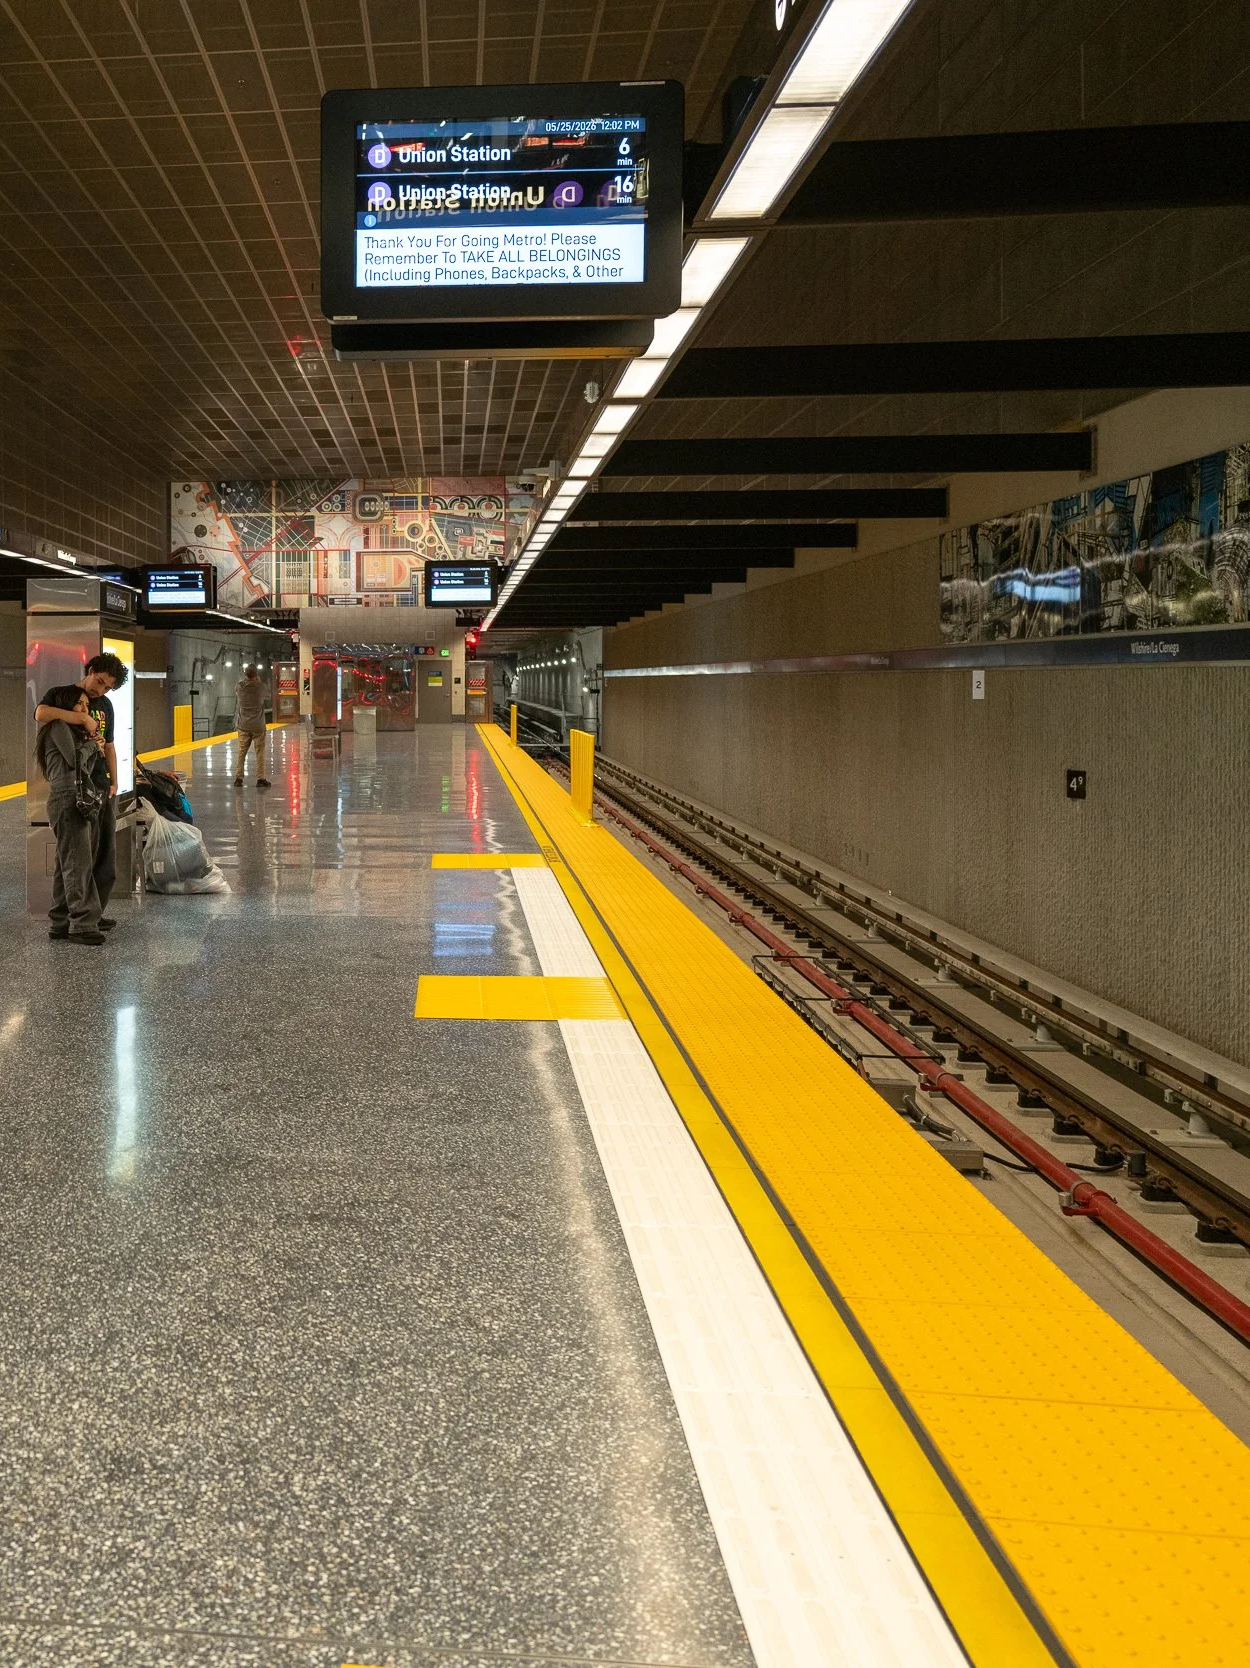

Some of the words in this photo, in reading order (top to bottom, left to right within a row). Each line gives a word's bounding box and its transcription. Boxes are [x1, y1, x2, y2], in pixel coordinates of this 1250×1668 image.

[545, 121, 597, 133] 05/25/2026
[601, 119, 623, 130] 12:02
[624, 120, 640, 130] PM
[374, 149, 386, 164] D
[399, 147, 447, 163] Union
[450, 145, 511, 162] Station
[618, 137, 630, 155] 6
[617, 157, 633, 166] min
[374, 186, 386, 201] D
[399, 184, 447, 201] Union
[450, 182, 511, 200] Station
[614, 175, 634, 193] 16
[616, 195, 632, 204] min
[364, 236, 404, 249] Thank
[407, 235, 432, 248] You
[436, 235, 457, 247] For
[461, 234, 499, 248] Going
[503, 233, 547, 246] Metro!
[551, 232, 597, 245] Please
[364, 252, 438, 265] Remember
[442, 251, 457, 263] To
[460, 250, 495, 263] TAKE
[498, 250, 525, 263] ALL
[529, 248, 621, 262] BELONGINGS
[364, 268, 431, 283] (Including
[435, 267, 488, 281] Phones,
[491, 266, 569, 280] Backpacks,
[572, 265, 582, 278] &
[586, 264, 624, 278] Other
[1159, 641, 1180, 657] Cienega
[975, 680, 982, 689] 2
